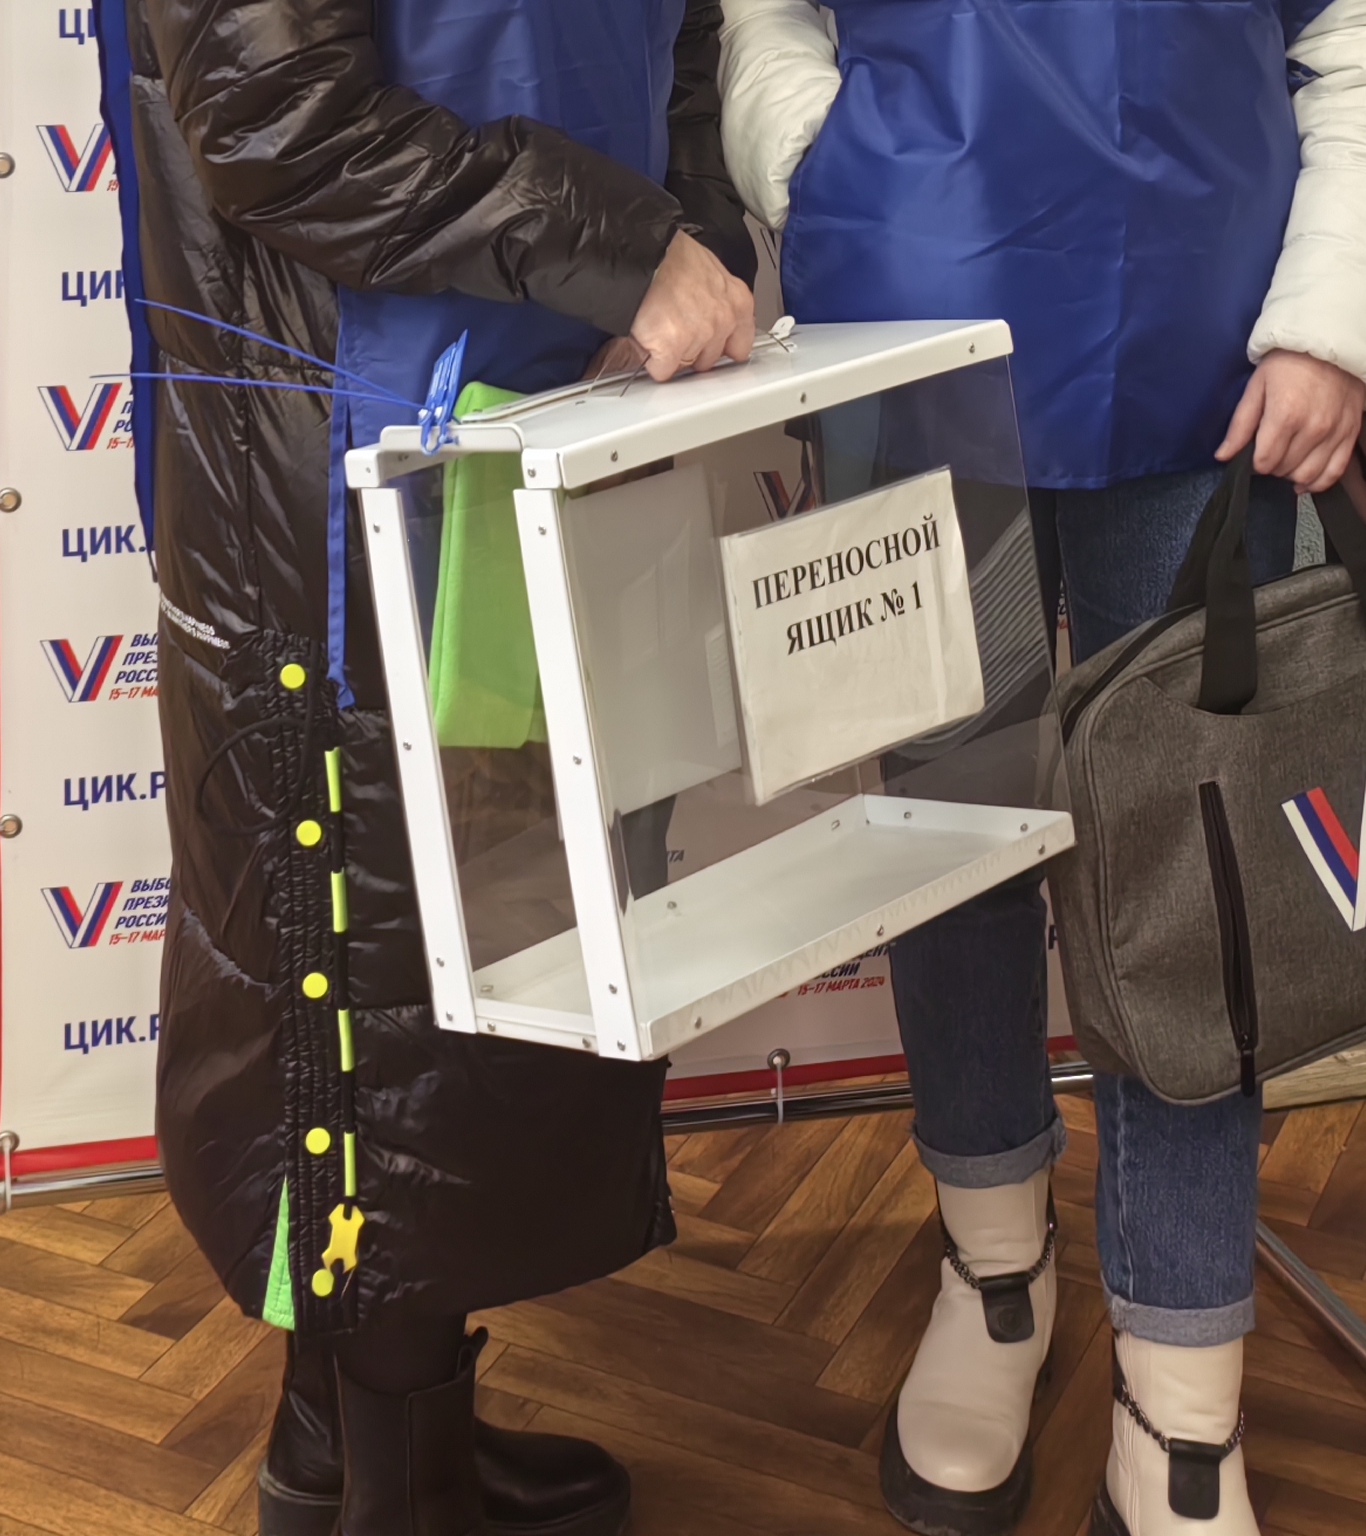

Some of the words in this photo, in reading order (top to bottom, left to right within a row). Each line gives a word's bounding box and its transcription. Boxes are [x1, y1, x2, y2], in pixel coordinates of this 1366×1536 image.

[62, 524, 146, 562] ЦИК.
[751, 513, 941, 610] ПЕРЕНОСНОЙ
[786, 597, 874, 656] ЯЩИК
[64, 771, 166, 811] ЦИК.Р
[115, 912, 167, 929] РОССИ
[64, 1014, 160, 1055] ЦИК.Р
